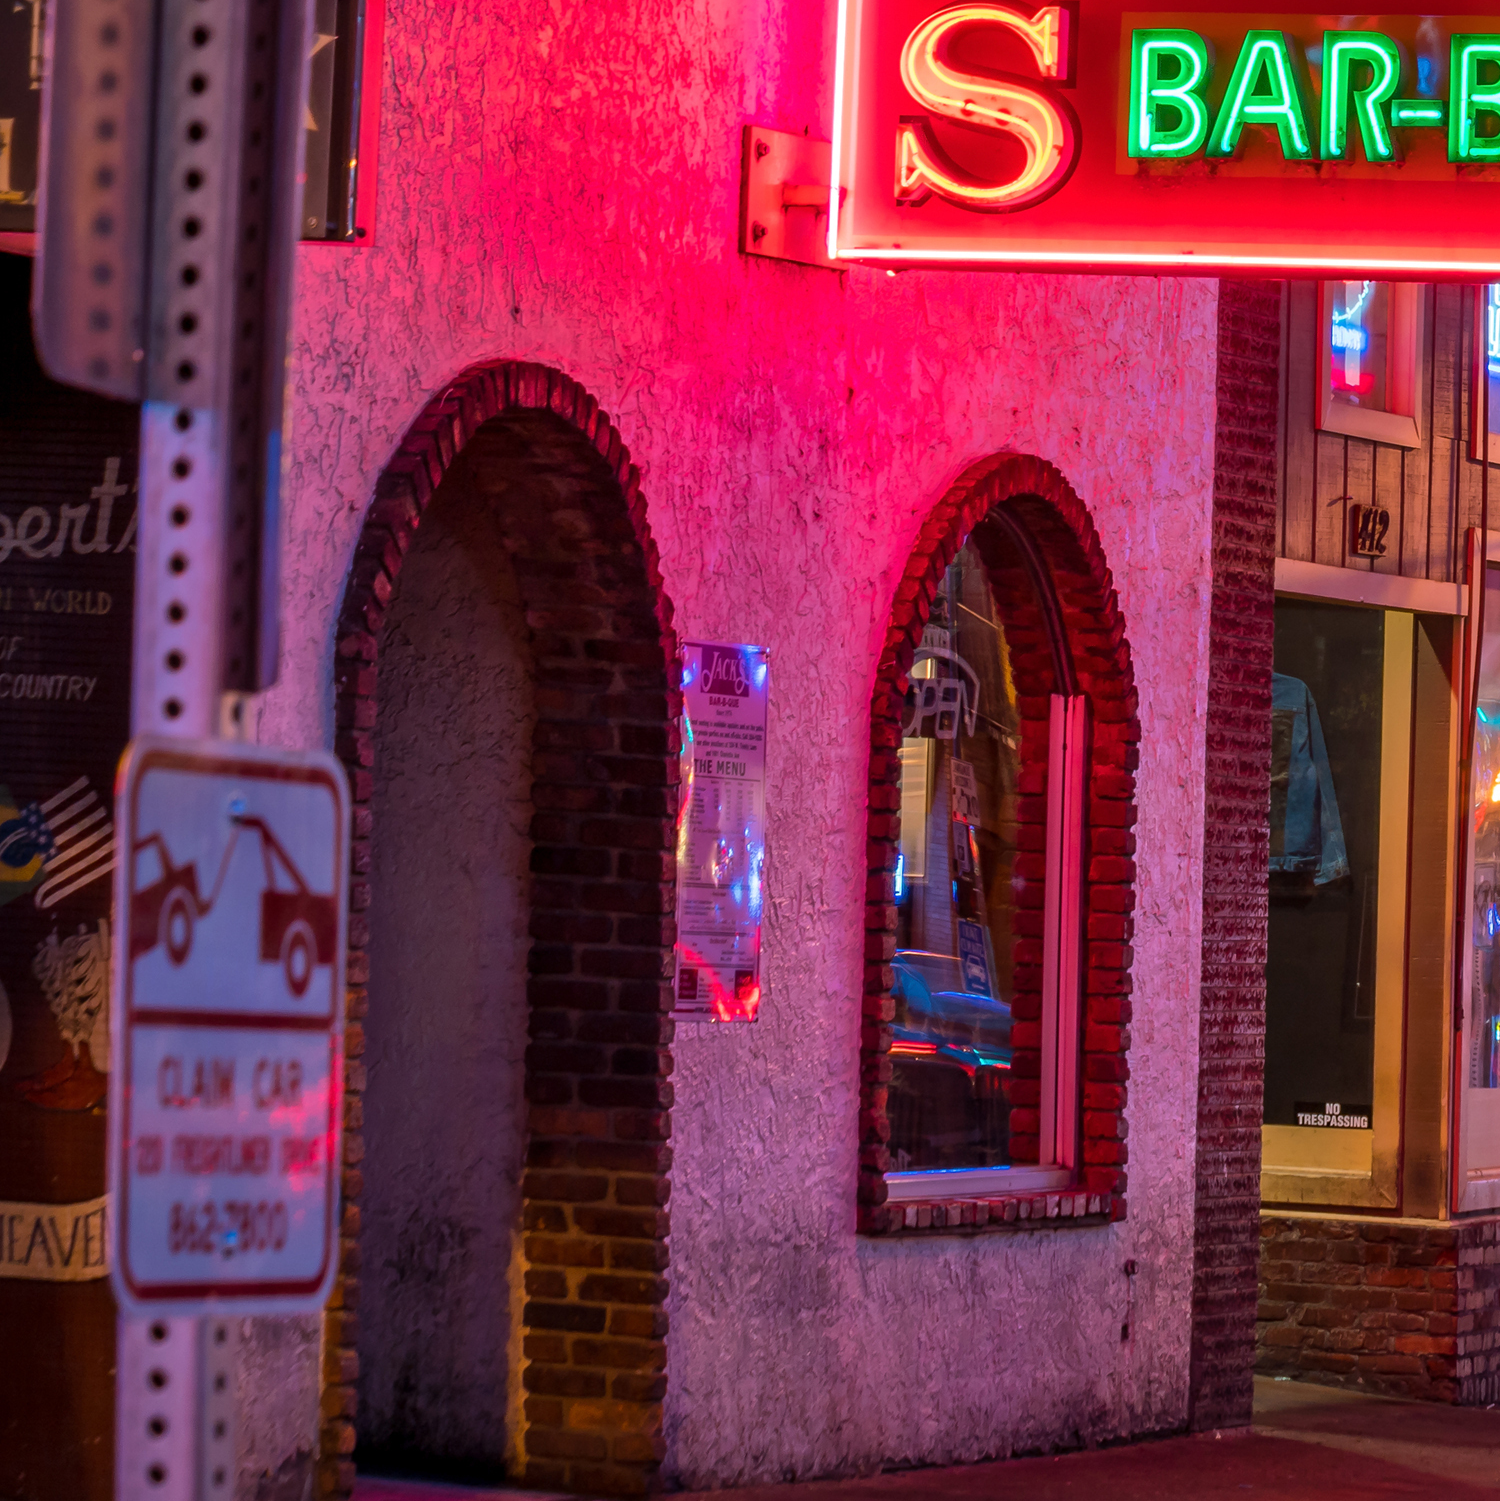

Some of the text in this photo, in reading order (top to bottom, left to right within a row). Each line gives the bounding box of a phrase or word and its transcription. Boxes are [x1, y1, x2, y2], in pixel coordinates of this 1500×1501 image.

[694, 758, 746, 777] THE MENU
[1325, 1102, 1341, 1115] NO
[1297, 1112, 1368, 1129] TRESPASSING
